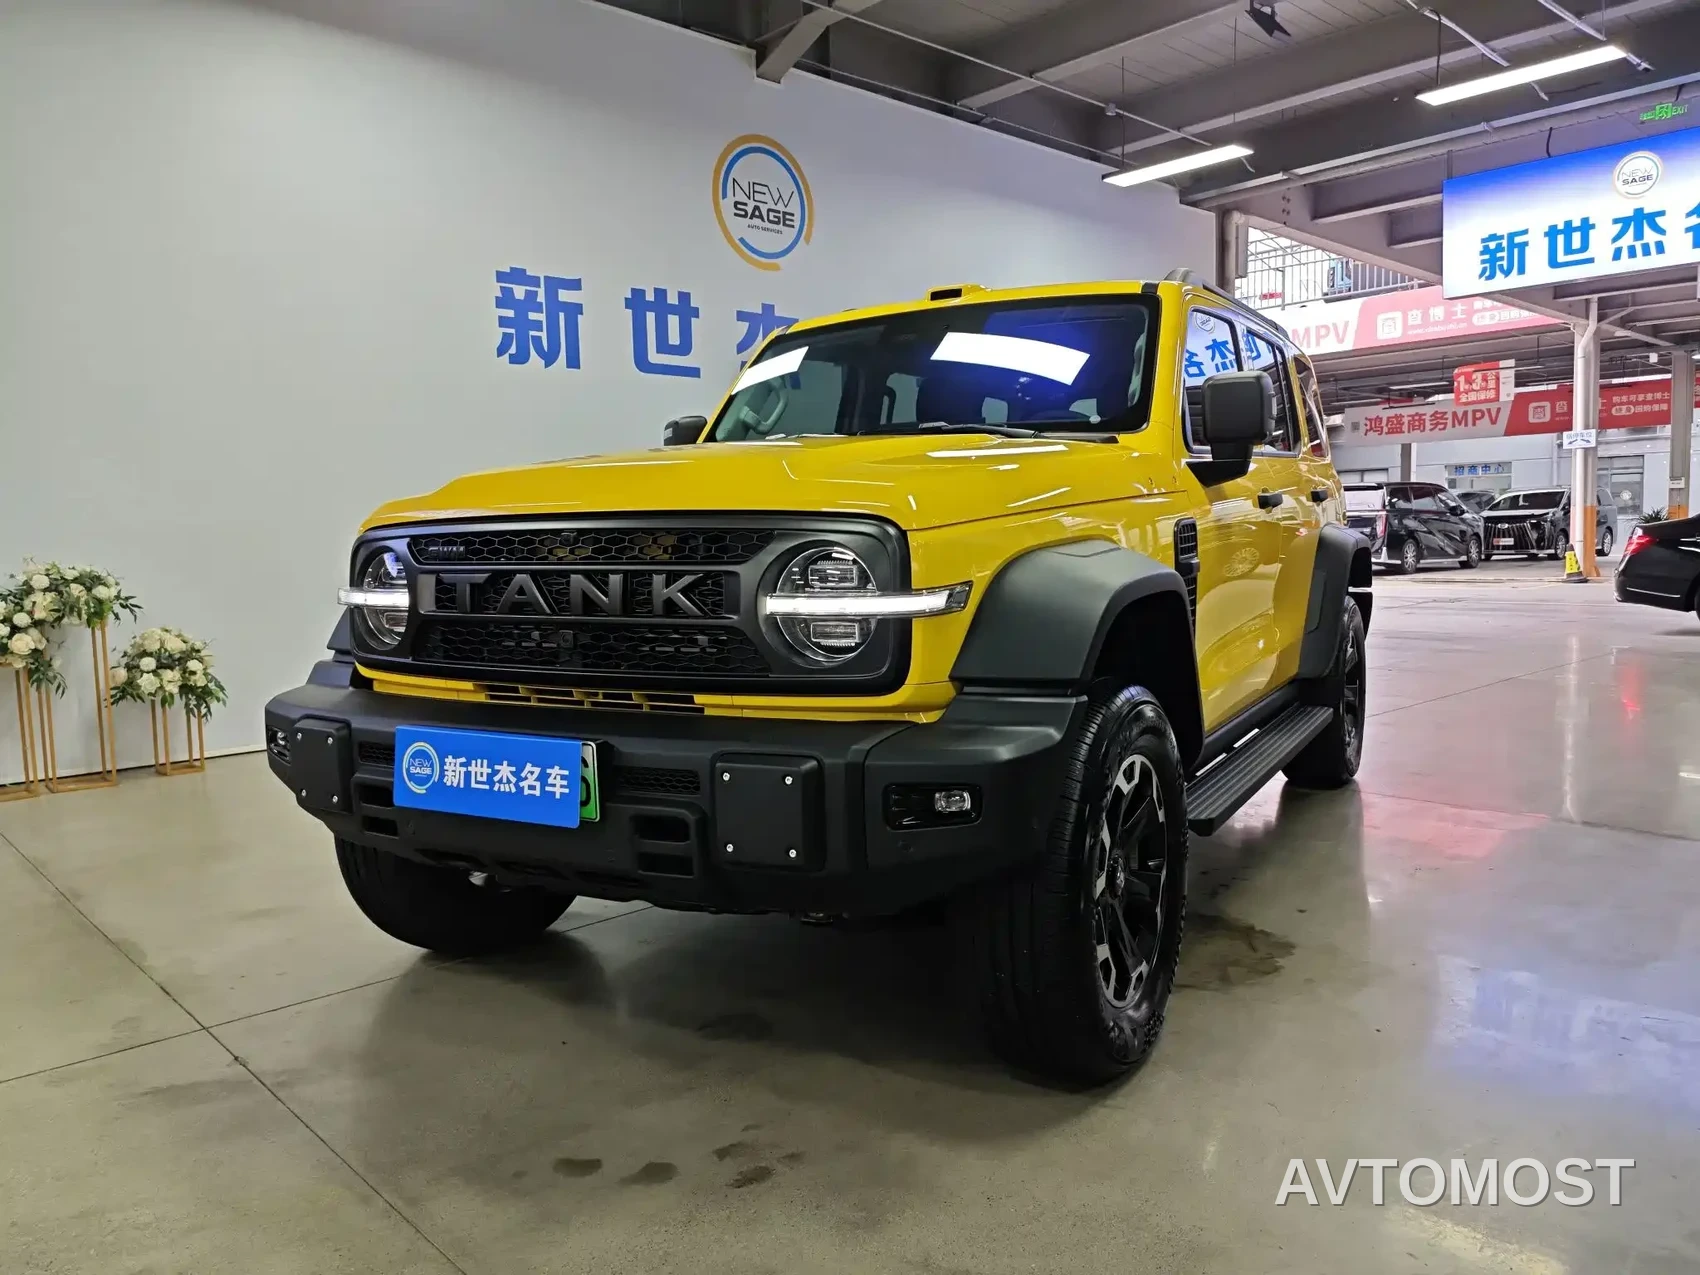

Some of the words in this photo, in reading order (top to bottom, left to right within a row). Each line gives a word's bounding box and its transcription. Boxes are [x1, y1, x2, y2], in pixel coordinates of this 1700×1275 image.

[1672, 104, 1688, 115] EXIT
[1621, 165, 1654, 179] NEW
[1621, 174, 1654, 186] SAGE
[732, 177, 795, 208] NEW
[733, 200, 795, 229] SAGE
[747, 223, 760, 231] AUTO
[1478, 201, 1700, 281] 新世杰
[1291, 320, 1350, 349] MPV
[1364, 407, 1501, 437] 鸿盛商务MPV
[1454, 464, 1505, 476] 招商中心
[437, 572, 709, 617] TANK
[409, 758, 432, 768] NEW
[409, 767, 432, 775] SAGE
[443, 755, 570, 799] 新世杰名车
